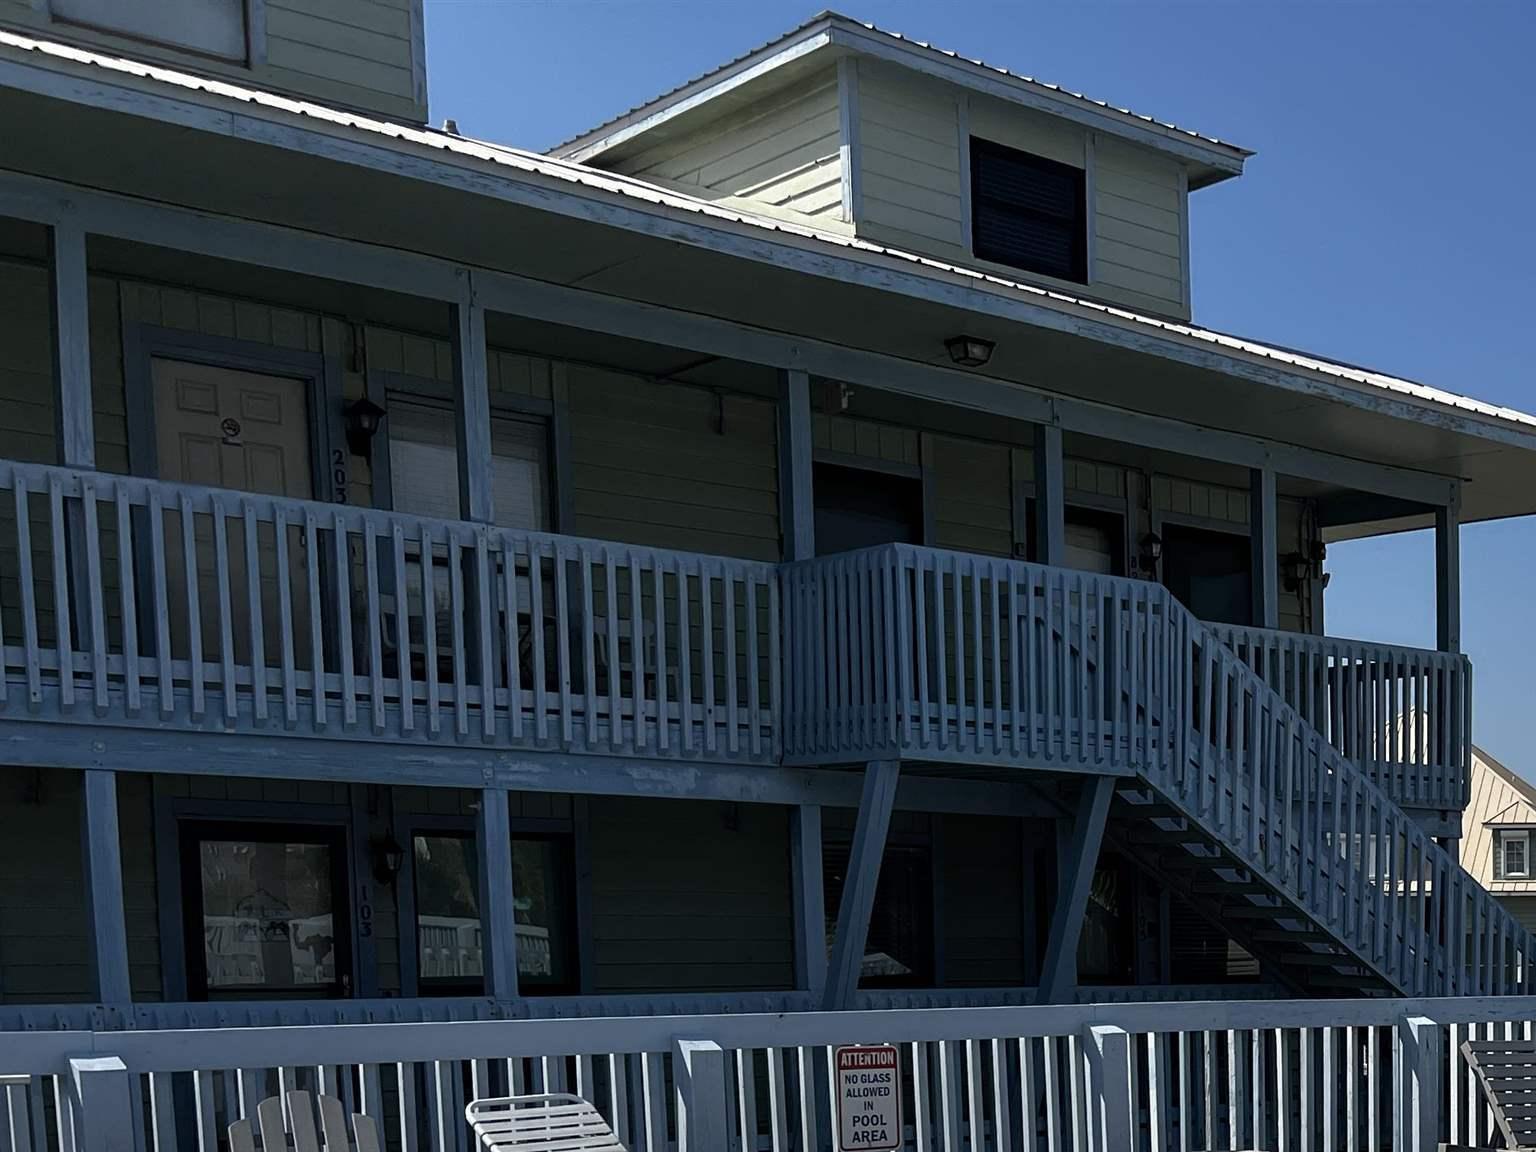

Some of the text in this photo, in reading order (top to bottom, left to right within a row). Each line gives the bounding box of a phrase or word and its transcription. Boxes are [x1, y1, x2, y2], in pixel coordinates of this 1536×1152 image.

[841, 1052, 894, 1066] ATTENTION
[845, 1073, 891, 1084] NO GLASS
[846, 1087, 890, 1098] ALLOWED
[863, 1101, 873, 1111] IN
[852, 1115, 887, 1126] POOL
[852, 1130, 888, 1143] AREA
